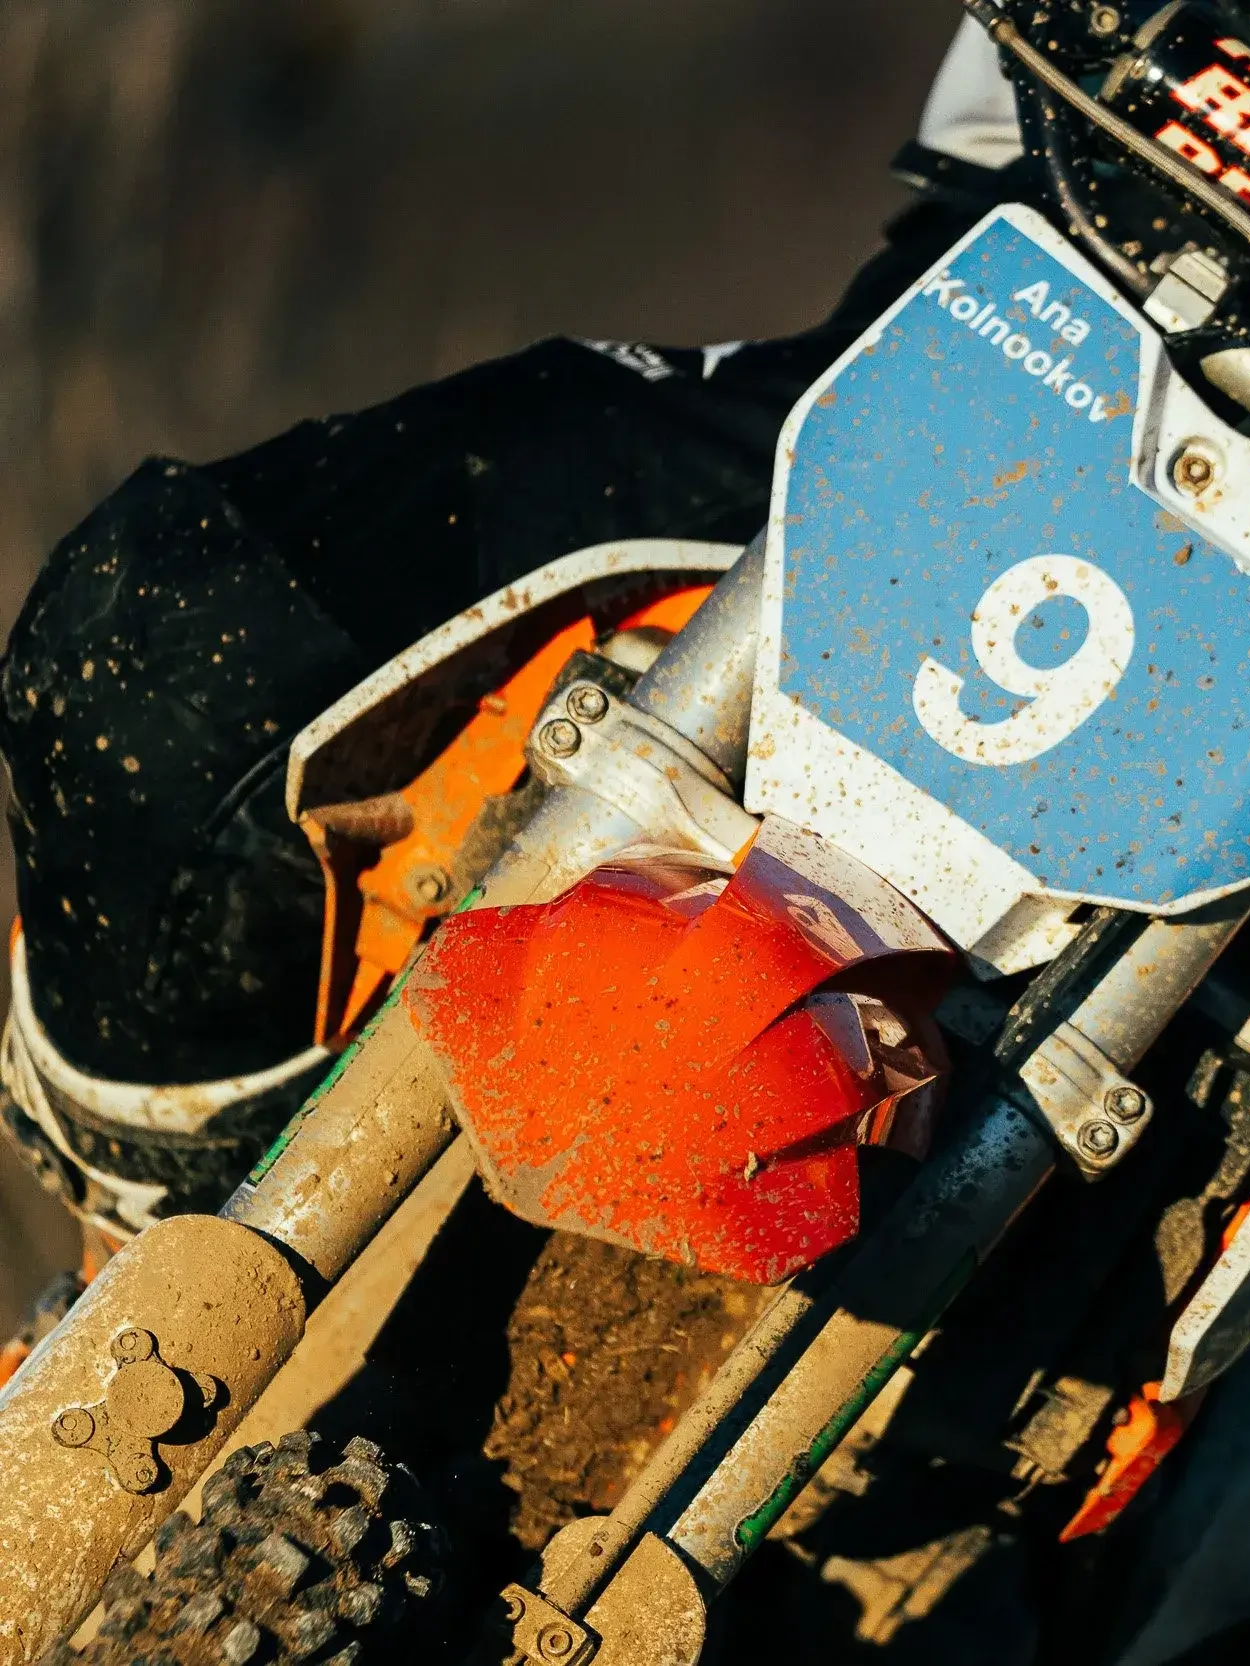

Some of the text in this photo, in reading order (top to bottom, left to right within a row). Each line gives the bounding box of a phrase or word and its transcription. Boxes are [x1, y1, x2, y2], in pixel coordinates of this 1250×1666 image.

[921, 269, 1108, 423] Kolnookov
[1013, 279, 1092, 347] Ana
[912, 553, 1136, 767] 9
